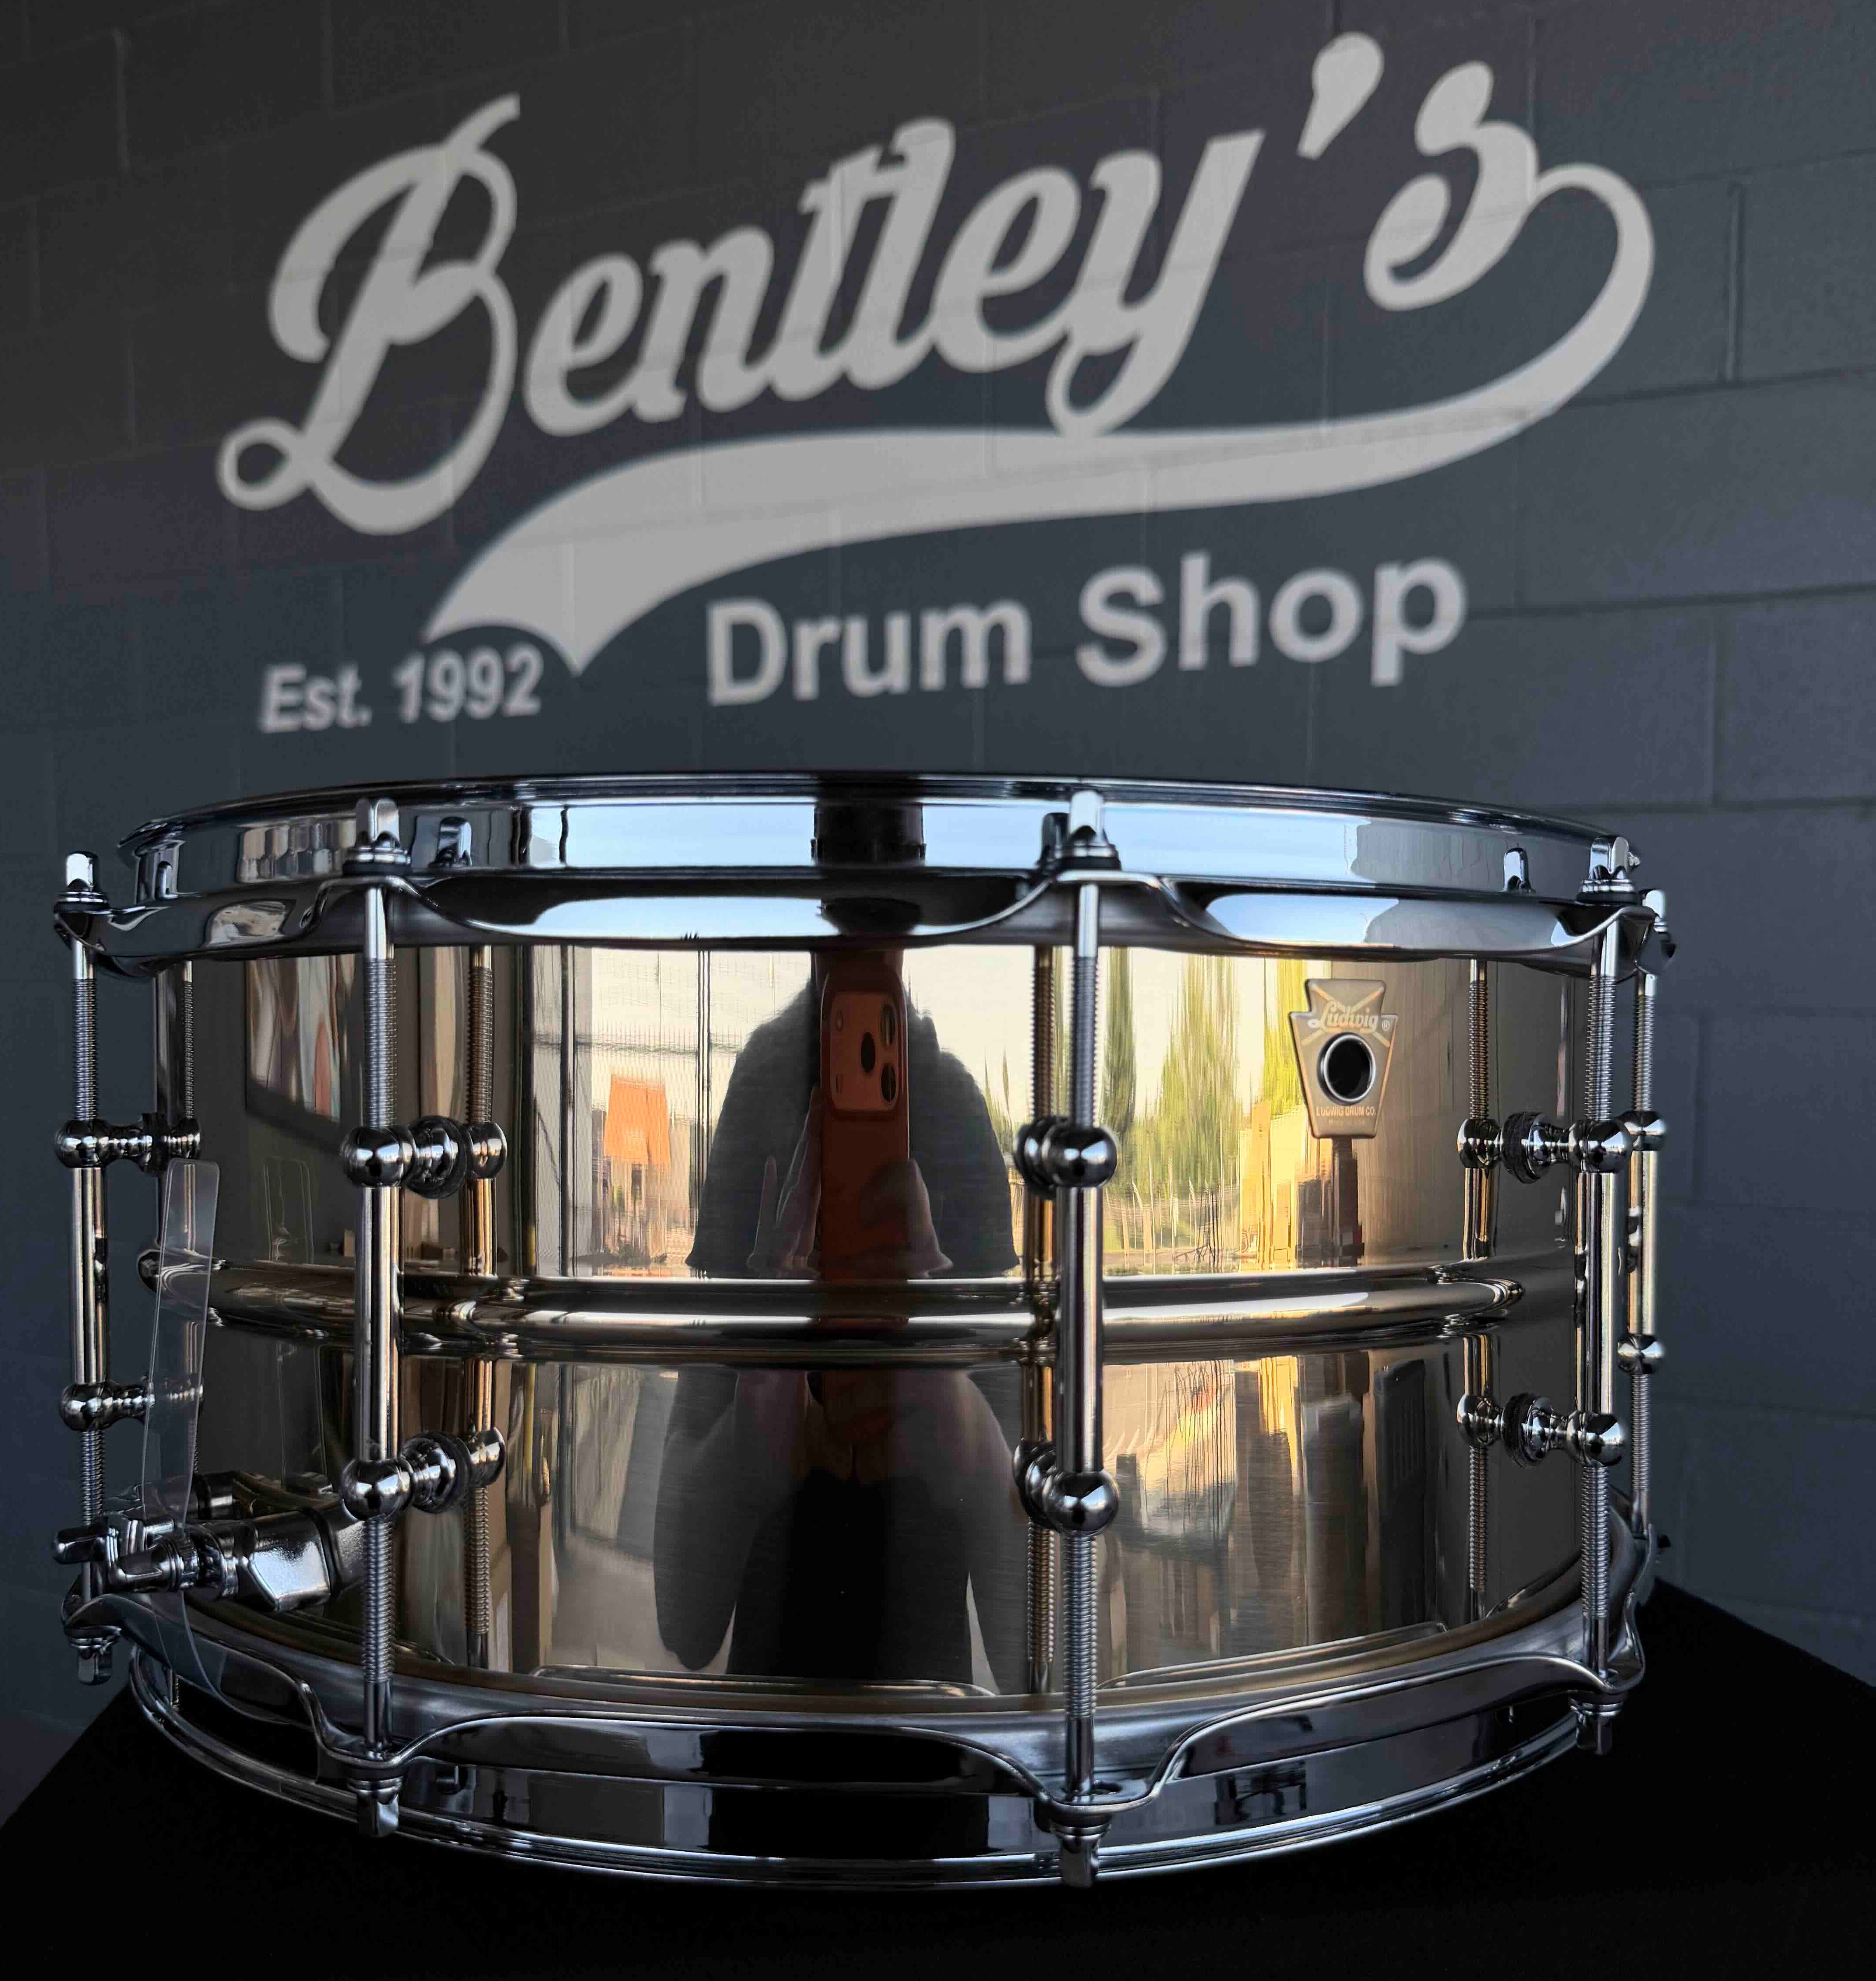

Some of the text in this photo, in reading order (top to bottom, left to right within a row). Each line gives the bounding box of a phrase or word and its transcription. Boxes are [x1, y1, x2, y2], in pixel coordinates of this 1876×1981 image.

[218, 32, 1655, 535] Bentley's
[707, 551, 1468, 706] Drum Shop
[259, 643, 543, 733] Est. 1992
[1307, 1000, 1379, 1033] Ludwig
[1315, 1105, 1376, 1116] LUDWIG DRUM CO.
